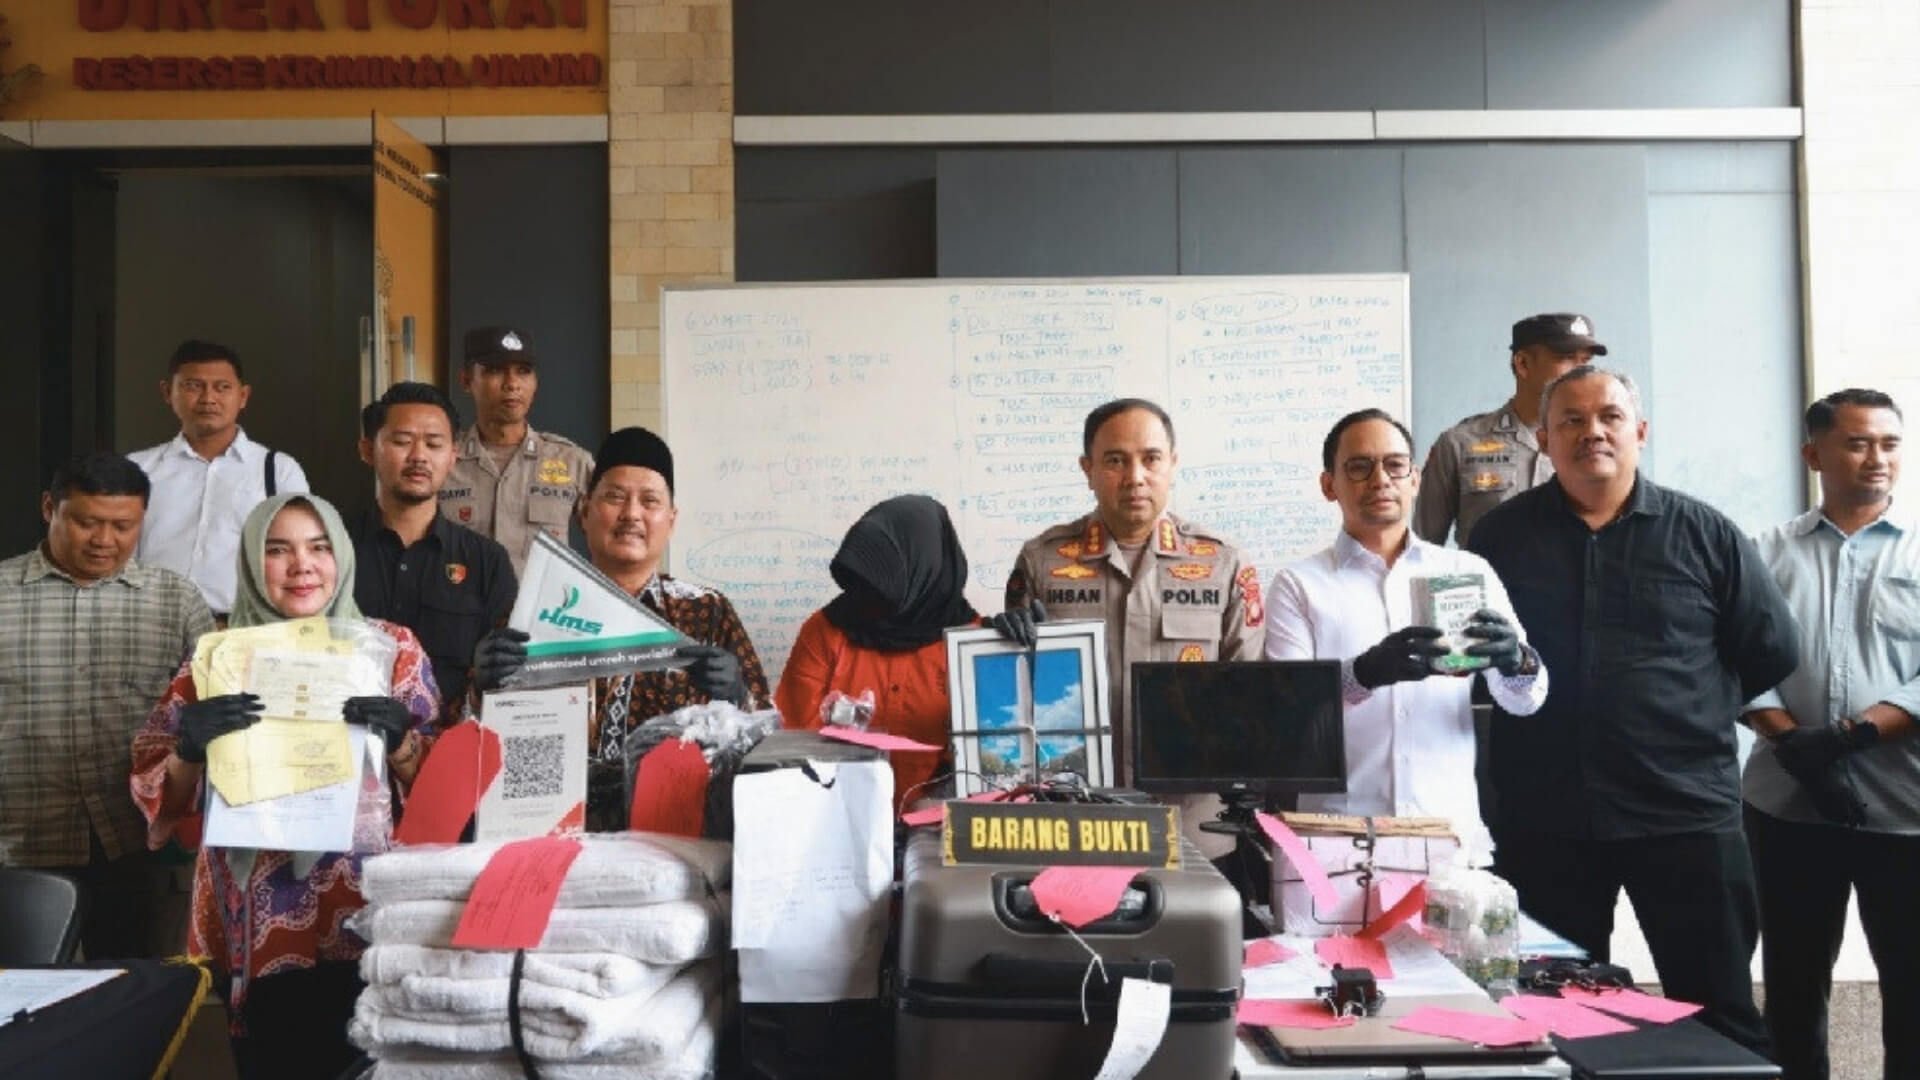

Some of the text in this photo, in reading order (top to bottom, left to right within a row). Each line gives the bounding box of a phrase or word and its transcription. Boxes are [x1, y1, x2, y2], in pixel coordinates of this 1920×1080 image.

[72, 52, 601, 91] RESERSE KRIMINAL UMUM
[529, 487, 576, 502] POLRI
[1048, 588, 1100, 604] IHSAN
[1162, 588, 1220, 605] POLRI
[971, 816, 1151, 852] BARANG BUKTI
